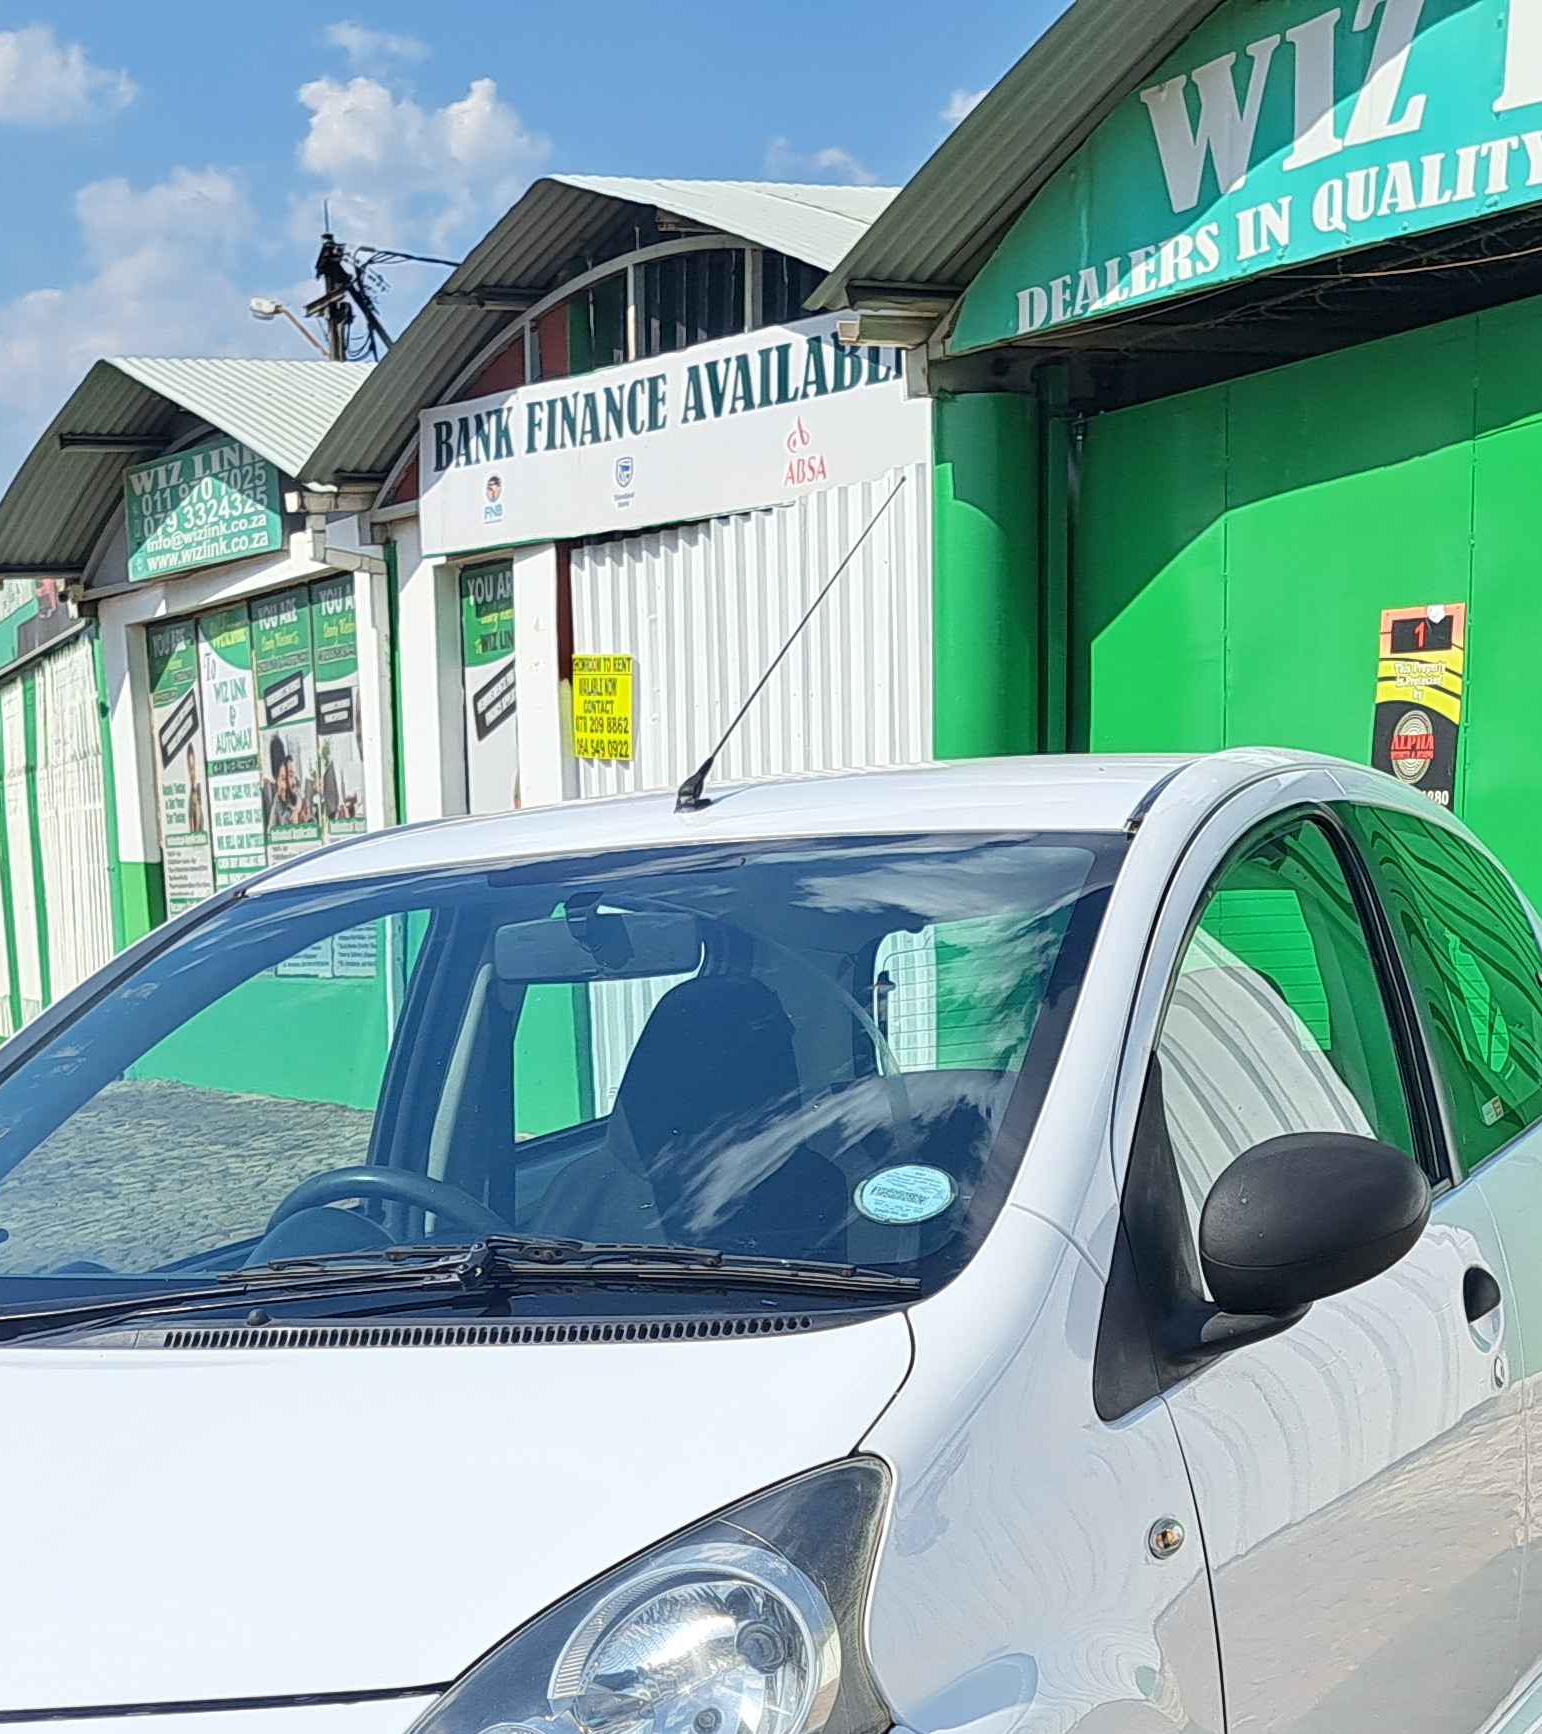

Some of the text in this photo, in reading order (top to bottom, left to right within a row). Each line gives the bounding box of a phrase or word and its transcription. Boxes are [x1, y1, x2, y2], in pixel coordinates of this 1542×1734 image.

[1140, 0, 1427, 214] WIZ
[1015, 222, 1221, 336] DEALERS
[1235, 196, 1294, 262] IN
[432, 406, 514, 473] BANK
[524, 373, 667, 455] FINANCE
[129, 459, 184, 497] WIZ
[141, 487, 172, 516] 011
[218, 461, 267, 496] 7025
[784, 455, 828, 486] ABSA
[143, 485, 268, 538] 079 3324325
[146, 513, 268, 553] info@wizlink.co.za
[146, 530, 269, 572] www.wizlink.co.za
[468, 574, 494, 606] YOU
[214, 681, 229, 705] WIZ
[230, 676, 248, 701] LINK
[583, 699, 614, 715] CONTACT
[607, 740, 630, 759] 0922
[1391, 735, 1435, 750] ALPHA
